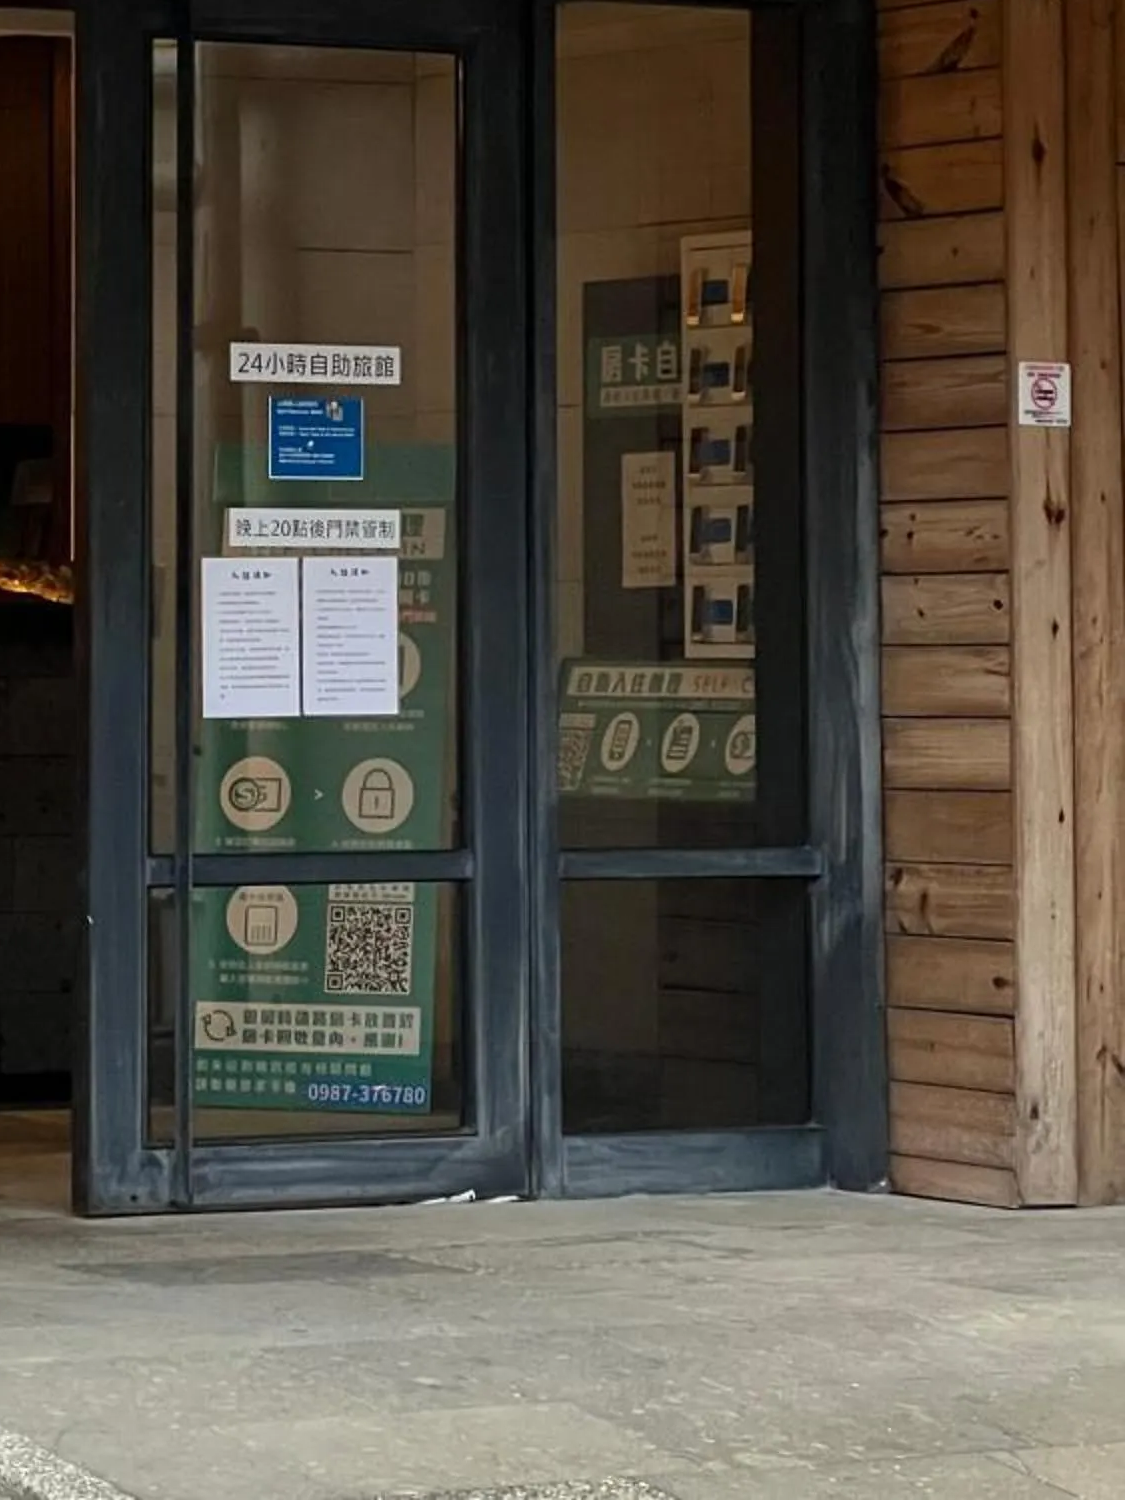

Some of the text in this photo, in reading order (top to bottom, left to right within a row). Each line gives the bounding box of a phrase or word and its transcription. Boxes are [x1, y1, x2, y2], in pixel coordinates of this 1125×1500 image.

[237, 352, 395, 378] 24小時自助旅館
[236, 518, 395, 540] 晚上20點後門禁管制
[308, 1083, 426, 1105] 0987-376780
